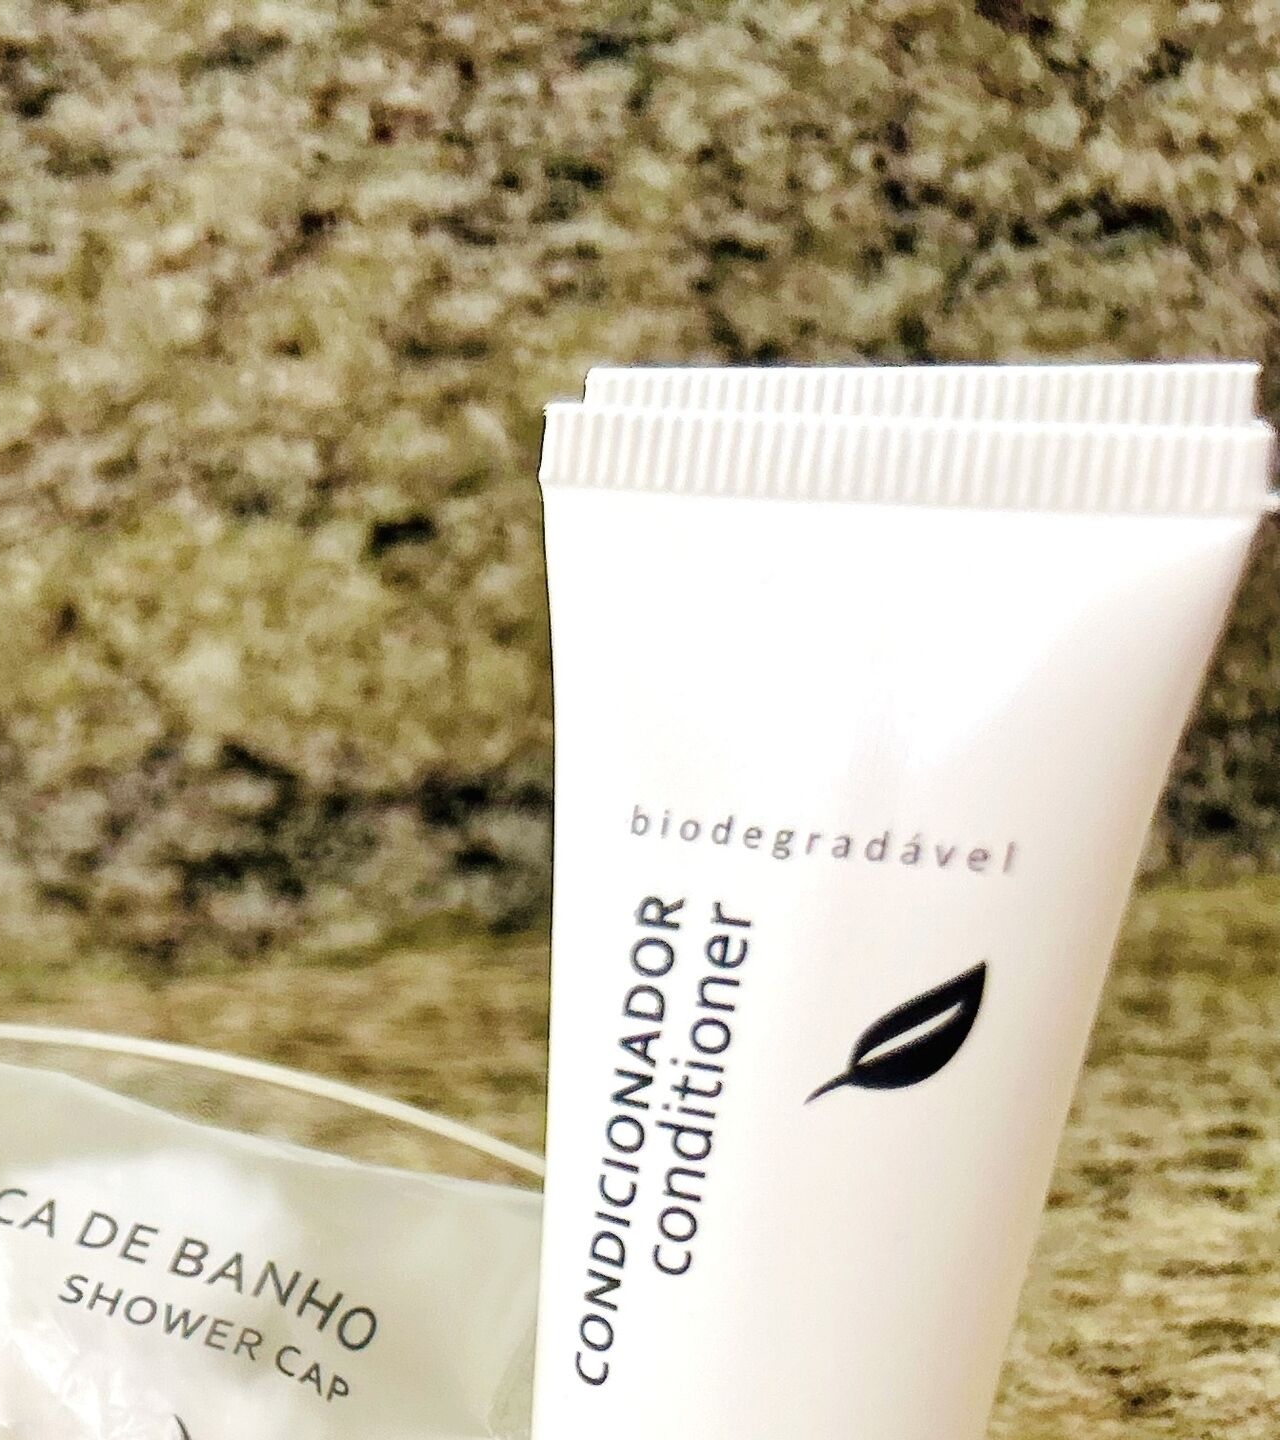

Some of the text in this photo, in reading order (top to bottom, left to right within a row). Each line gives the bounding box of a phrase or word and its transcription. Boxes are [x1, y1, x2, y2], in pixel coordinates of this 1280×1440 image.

[630, 804, 1017, 874] biodegradável
[575, 894, 686, 1386] CONDICIONADOR
[653, 900, 754, 1276] conditioner
[58, 1272, 350, 1402] SHOWER CAP
[77, 1209, 160, 1265] DE
[168, 1236, 379, 1353] BANHO
